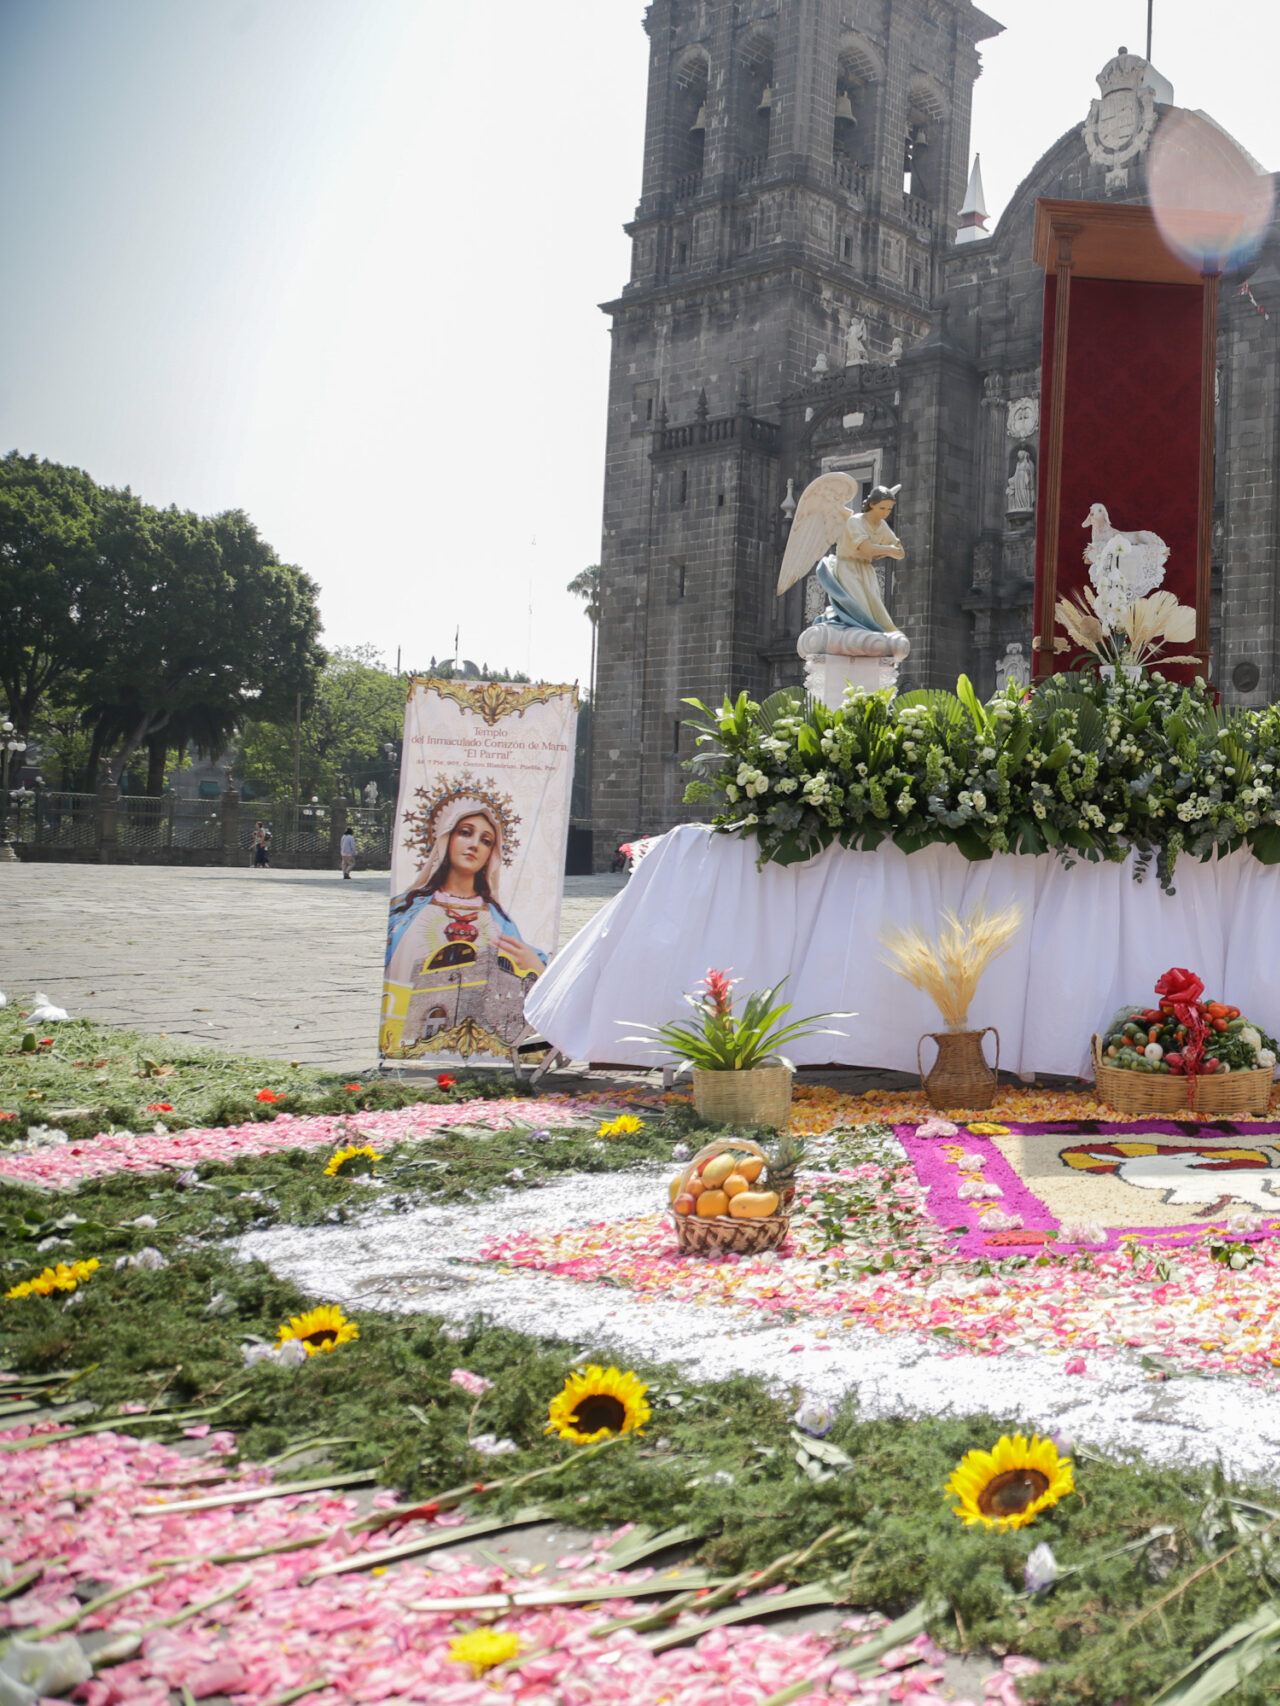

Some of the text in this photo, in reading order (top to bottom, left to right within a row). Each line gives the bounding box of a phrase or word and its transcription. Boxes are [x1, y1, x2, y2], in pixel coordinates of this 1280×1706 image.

[473, 726, 508, 739] Templo
[411, 735, 425, 744] del
[427, 736, 482, 747] Inmaculado
[528, 741, 539, 750] de
